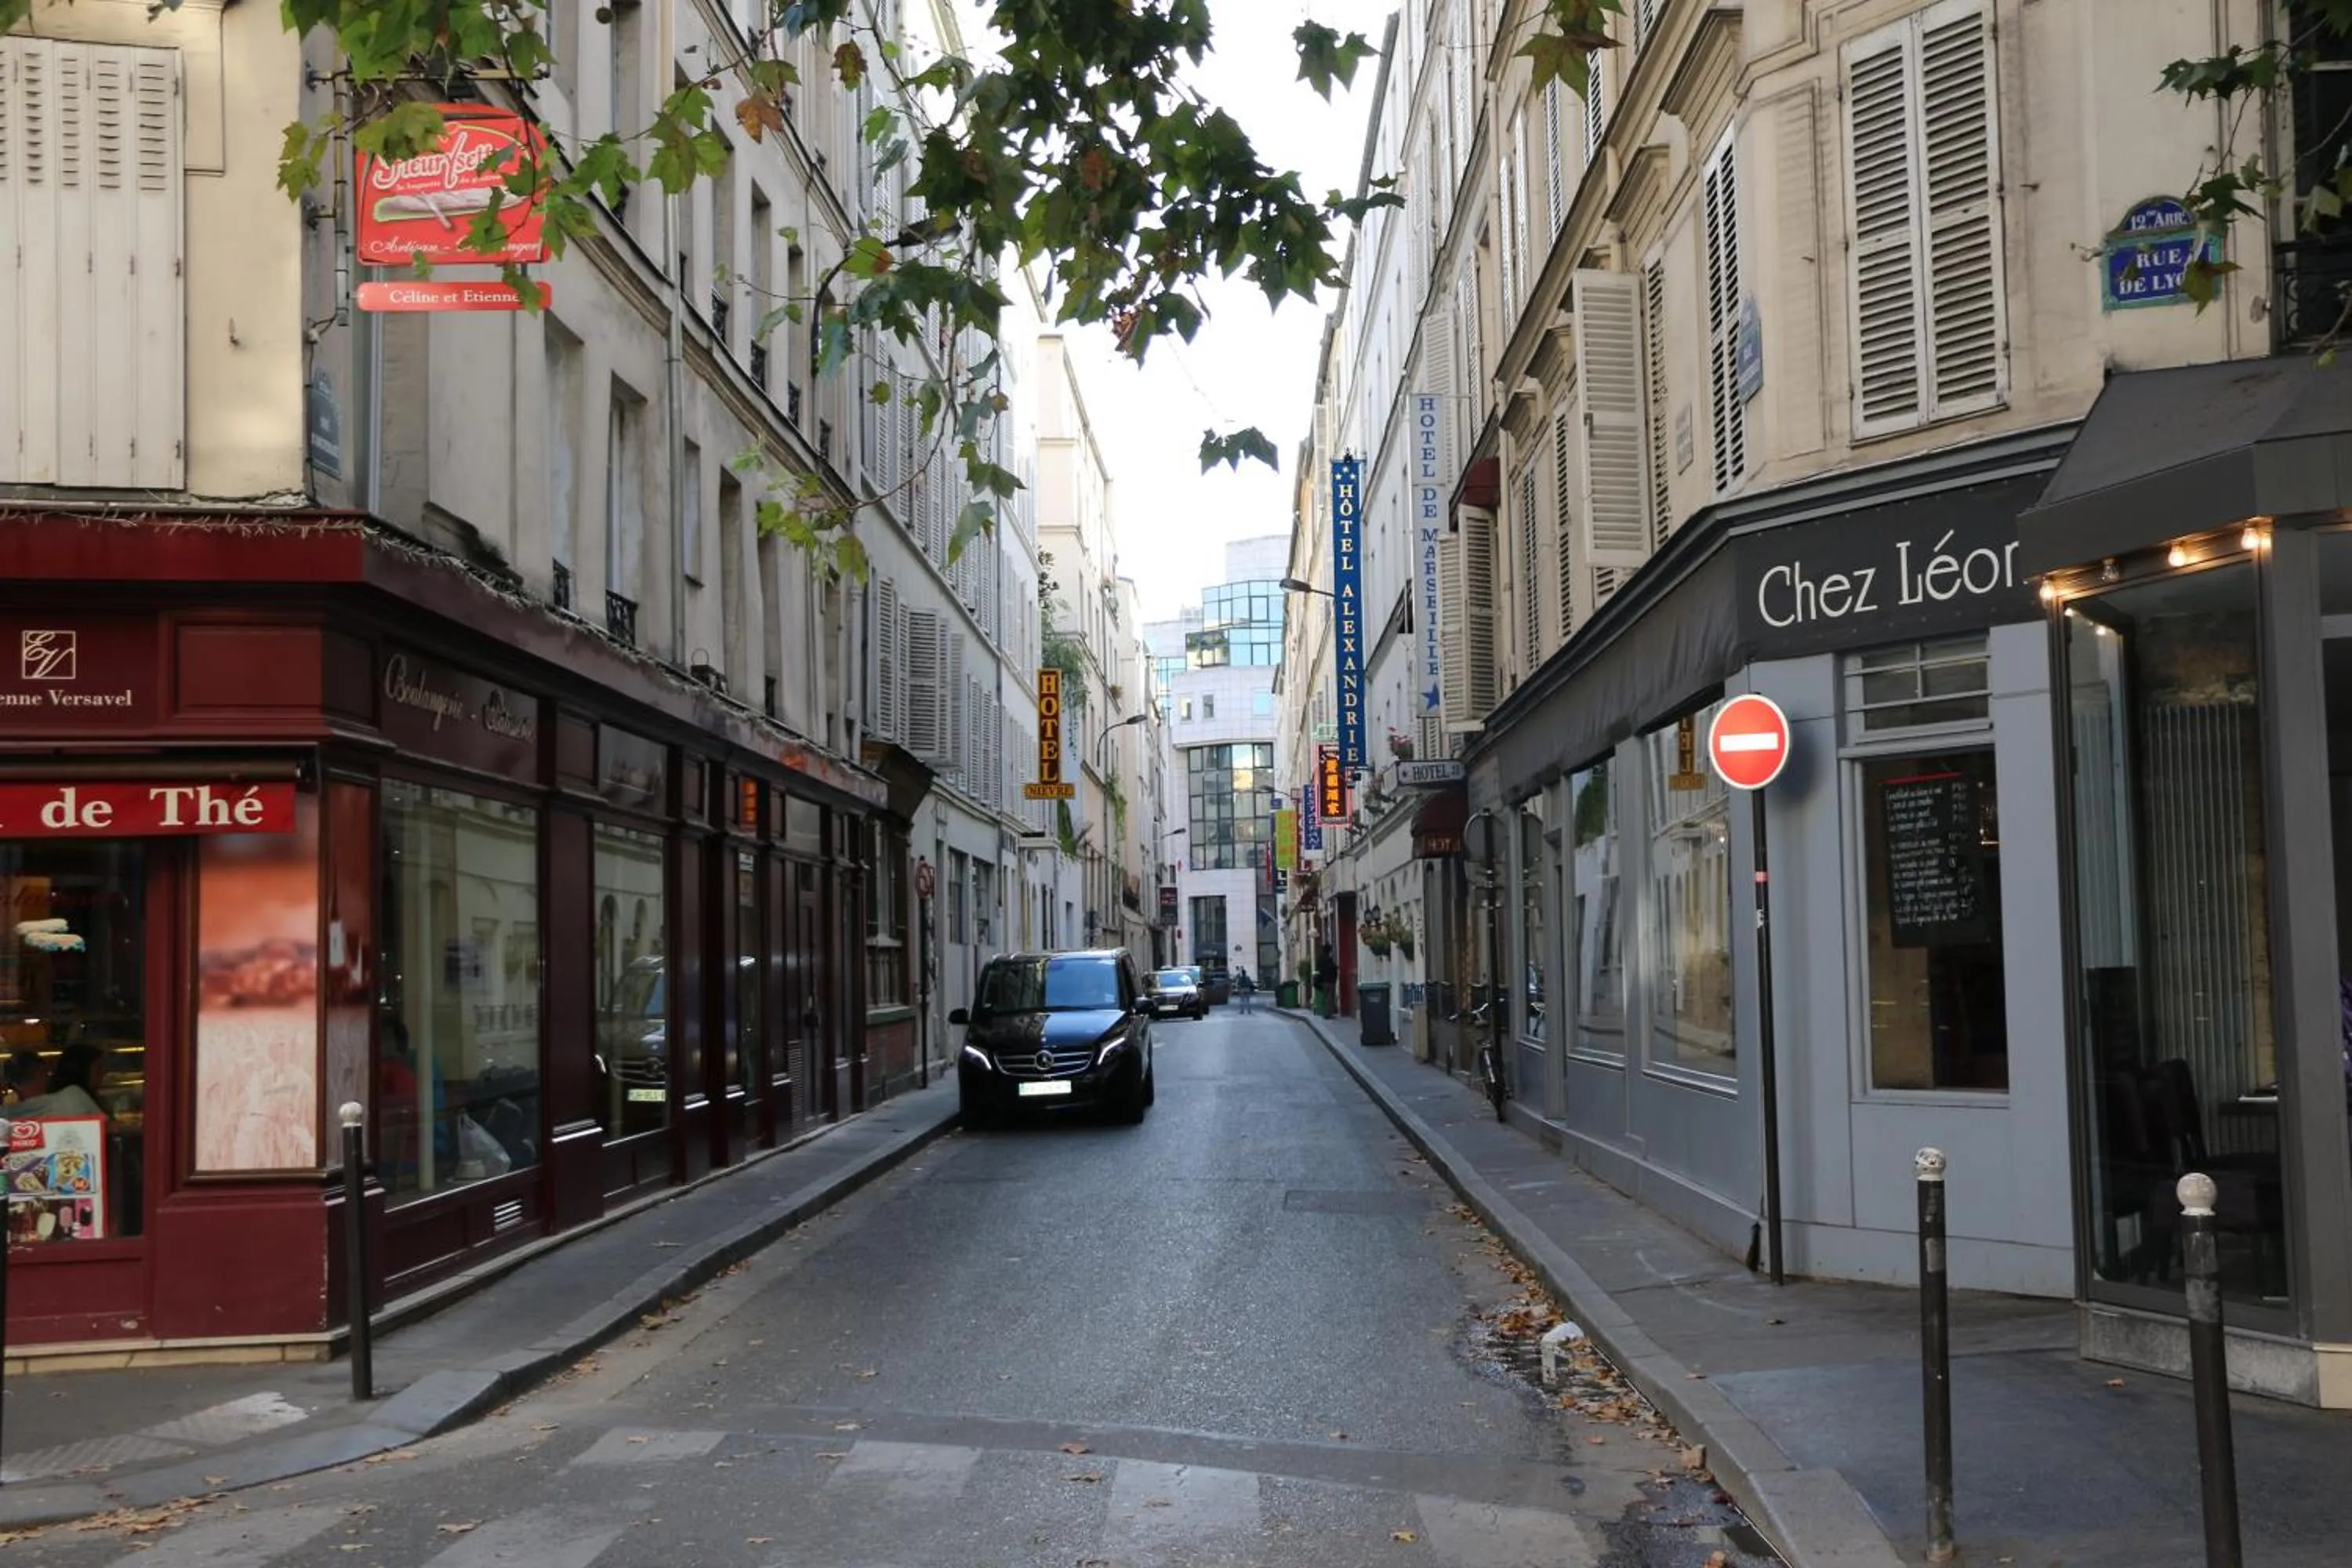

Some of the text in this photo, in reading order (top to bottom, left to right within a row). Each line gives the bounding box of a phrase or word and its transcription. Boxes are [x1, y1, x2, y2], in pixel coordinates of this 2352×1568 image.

[2136, 248, 2182, 268] RUE
[390, 289, 439, 303] Céline
[444, 292, 458, 303] et
[2119, 276, 2147, 295] DE
[1419, 397, 1440, 676] HOTEL DE MARSEILLE
[1759, 561, 1878, 627] Chez
[1339, 484, 1359, 762] HÔTEL ALEXANDRIE
[49, 689, 132, 706] Versavel
[1040, 674, 1058, 782] HOTEL
[1412, 764, 1451, 781] HOTEL
[41, 785, 264, 829] de Thé
